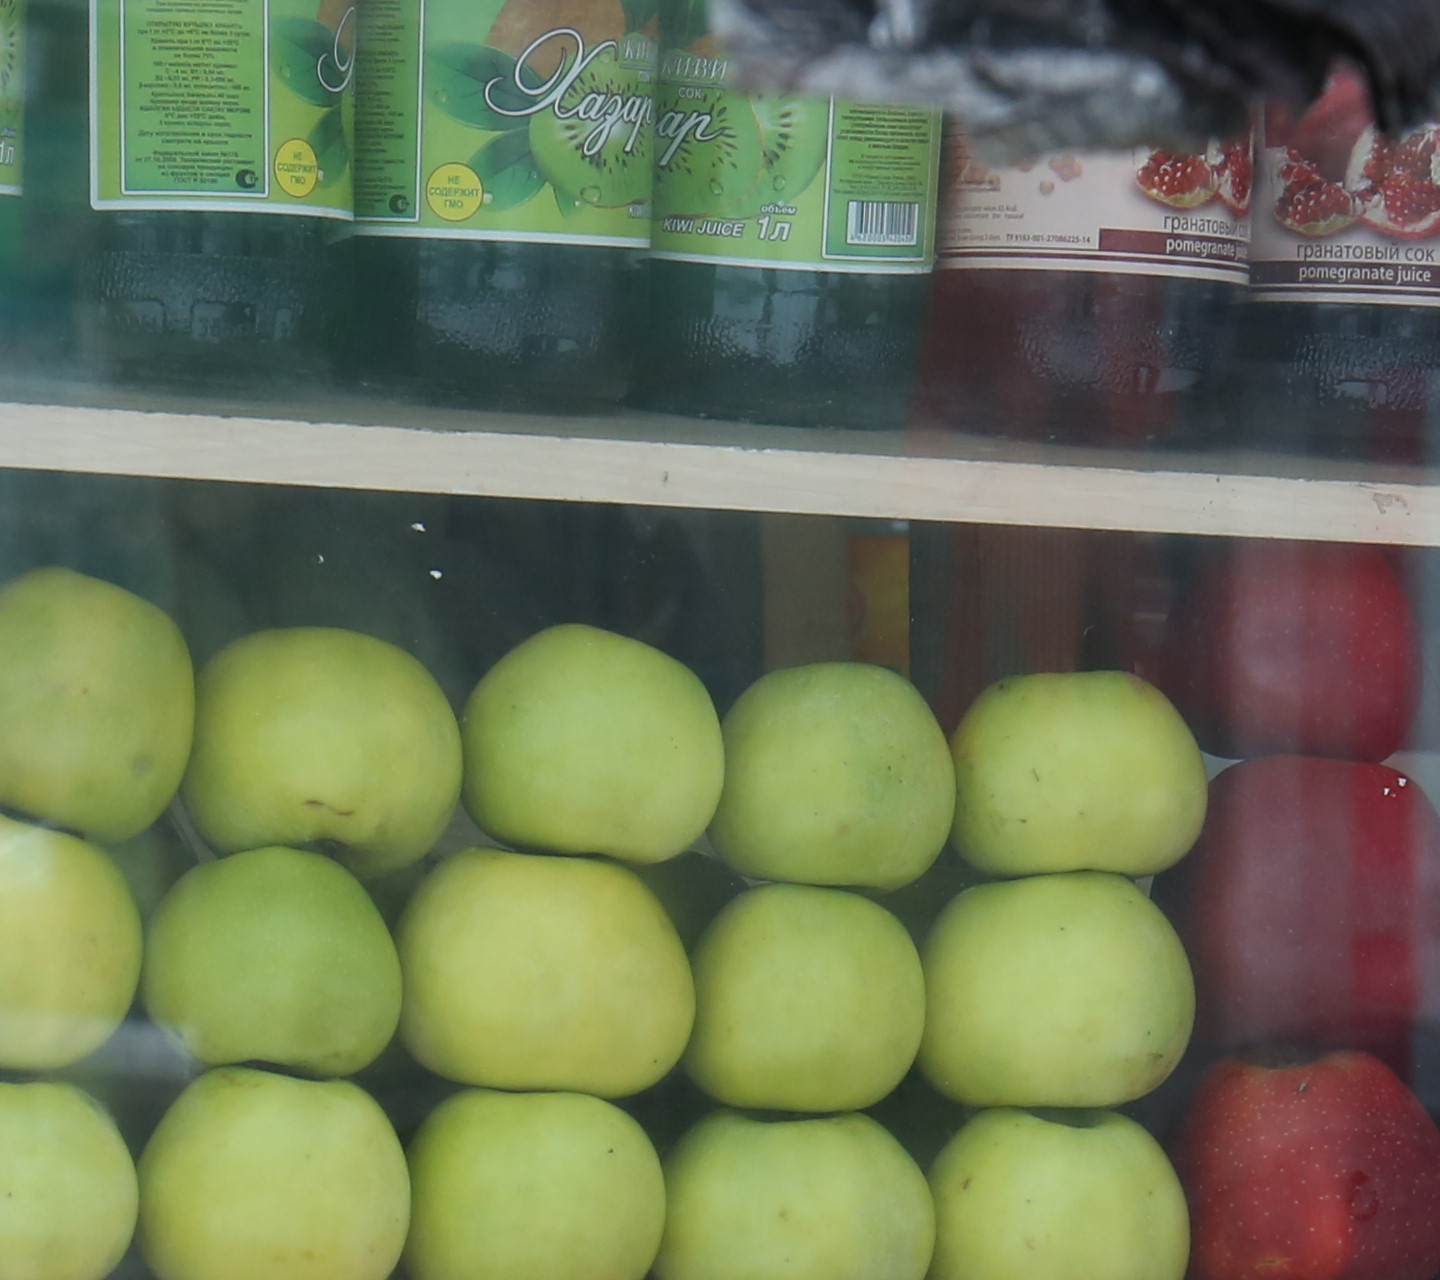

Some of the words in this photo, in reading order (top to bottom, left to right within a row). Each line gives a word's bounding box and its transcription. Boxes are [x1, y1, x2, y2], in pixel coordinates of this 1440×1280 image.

[678, 86, 704, 99] СОК
[662, 217, 694, 234] KIWI
[695, 221, 744, 238] JUICE
[755, 215, 792, 242] 1л
[1296, 242, 1400, 262] гранатовый
[1404, 247, 1436, 263] сок
[1298, 265, 1395, 283] pomegranate
[1396, 267, 1432, 285] juice
